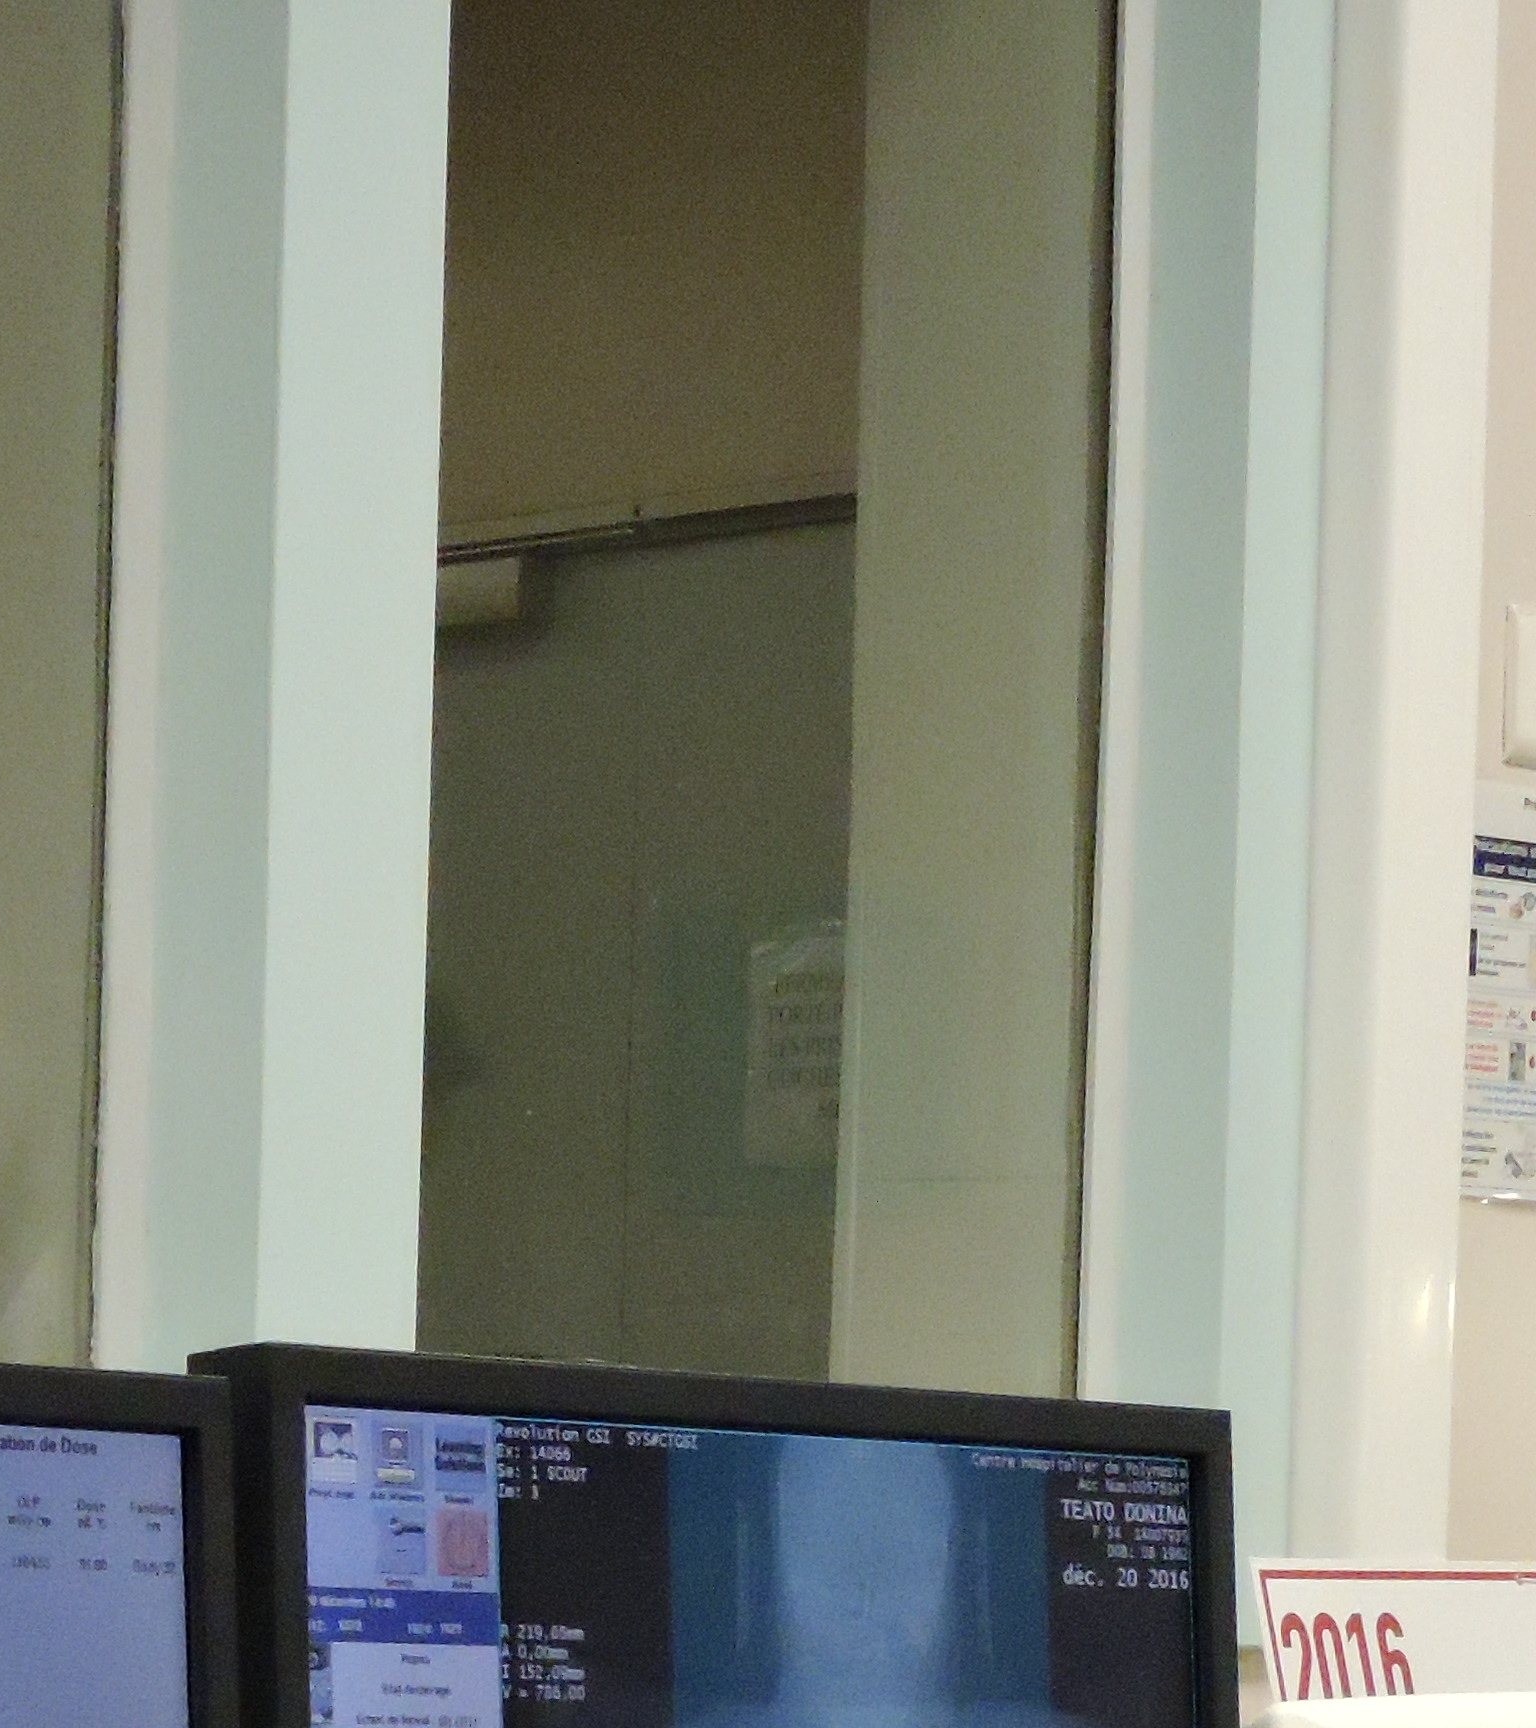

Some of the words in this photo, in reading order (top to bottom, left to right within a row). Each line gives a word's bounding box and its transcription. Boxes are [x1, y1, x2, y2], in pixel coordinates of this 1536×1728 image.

[39, 1435, 57, 1454] de
[61, 1435, 98, 1456] Dose
[547, 1465, 589, 1483] SCOUT
[1061, 1499, 1115, 1521] TEATO
[1063, 1561, 1105, 1587] déc.
[1117, 1567, 1139, 1588] 20
[1147, 1568, 1190, 1590] 2016
[1280, 1611, 1415, 1702] 2016
